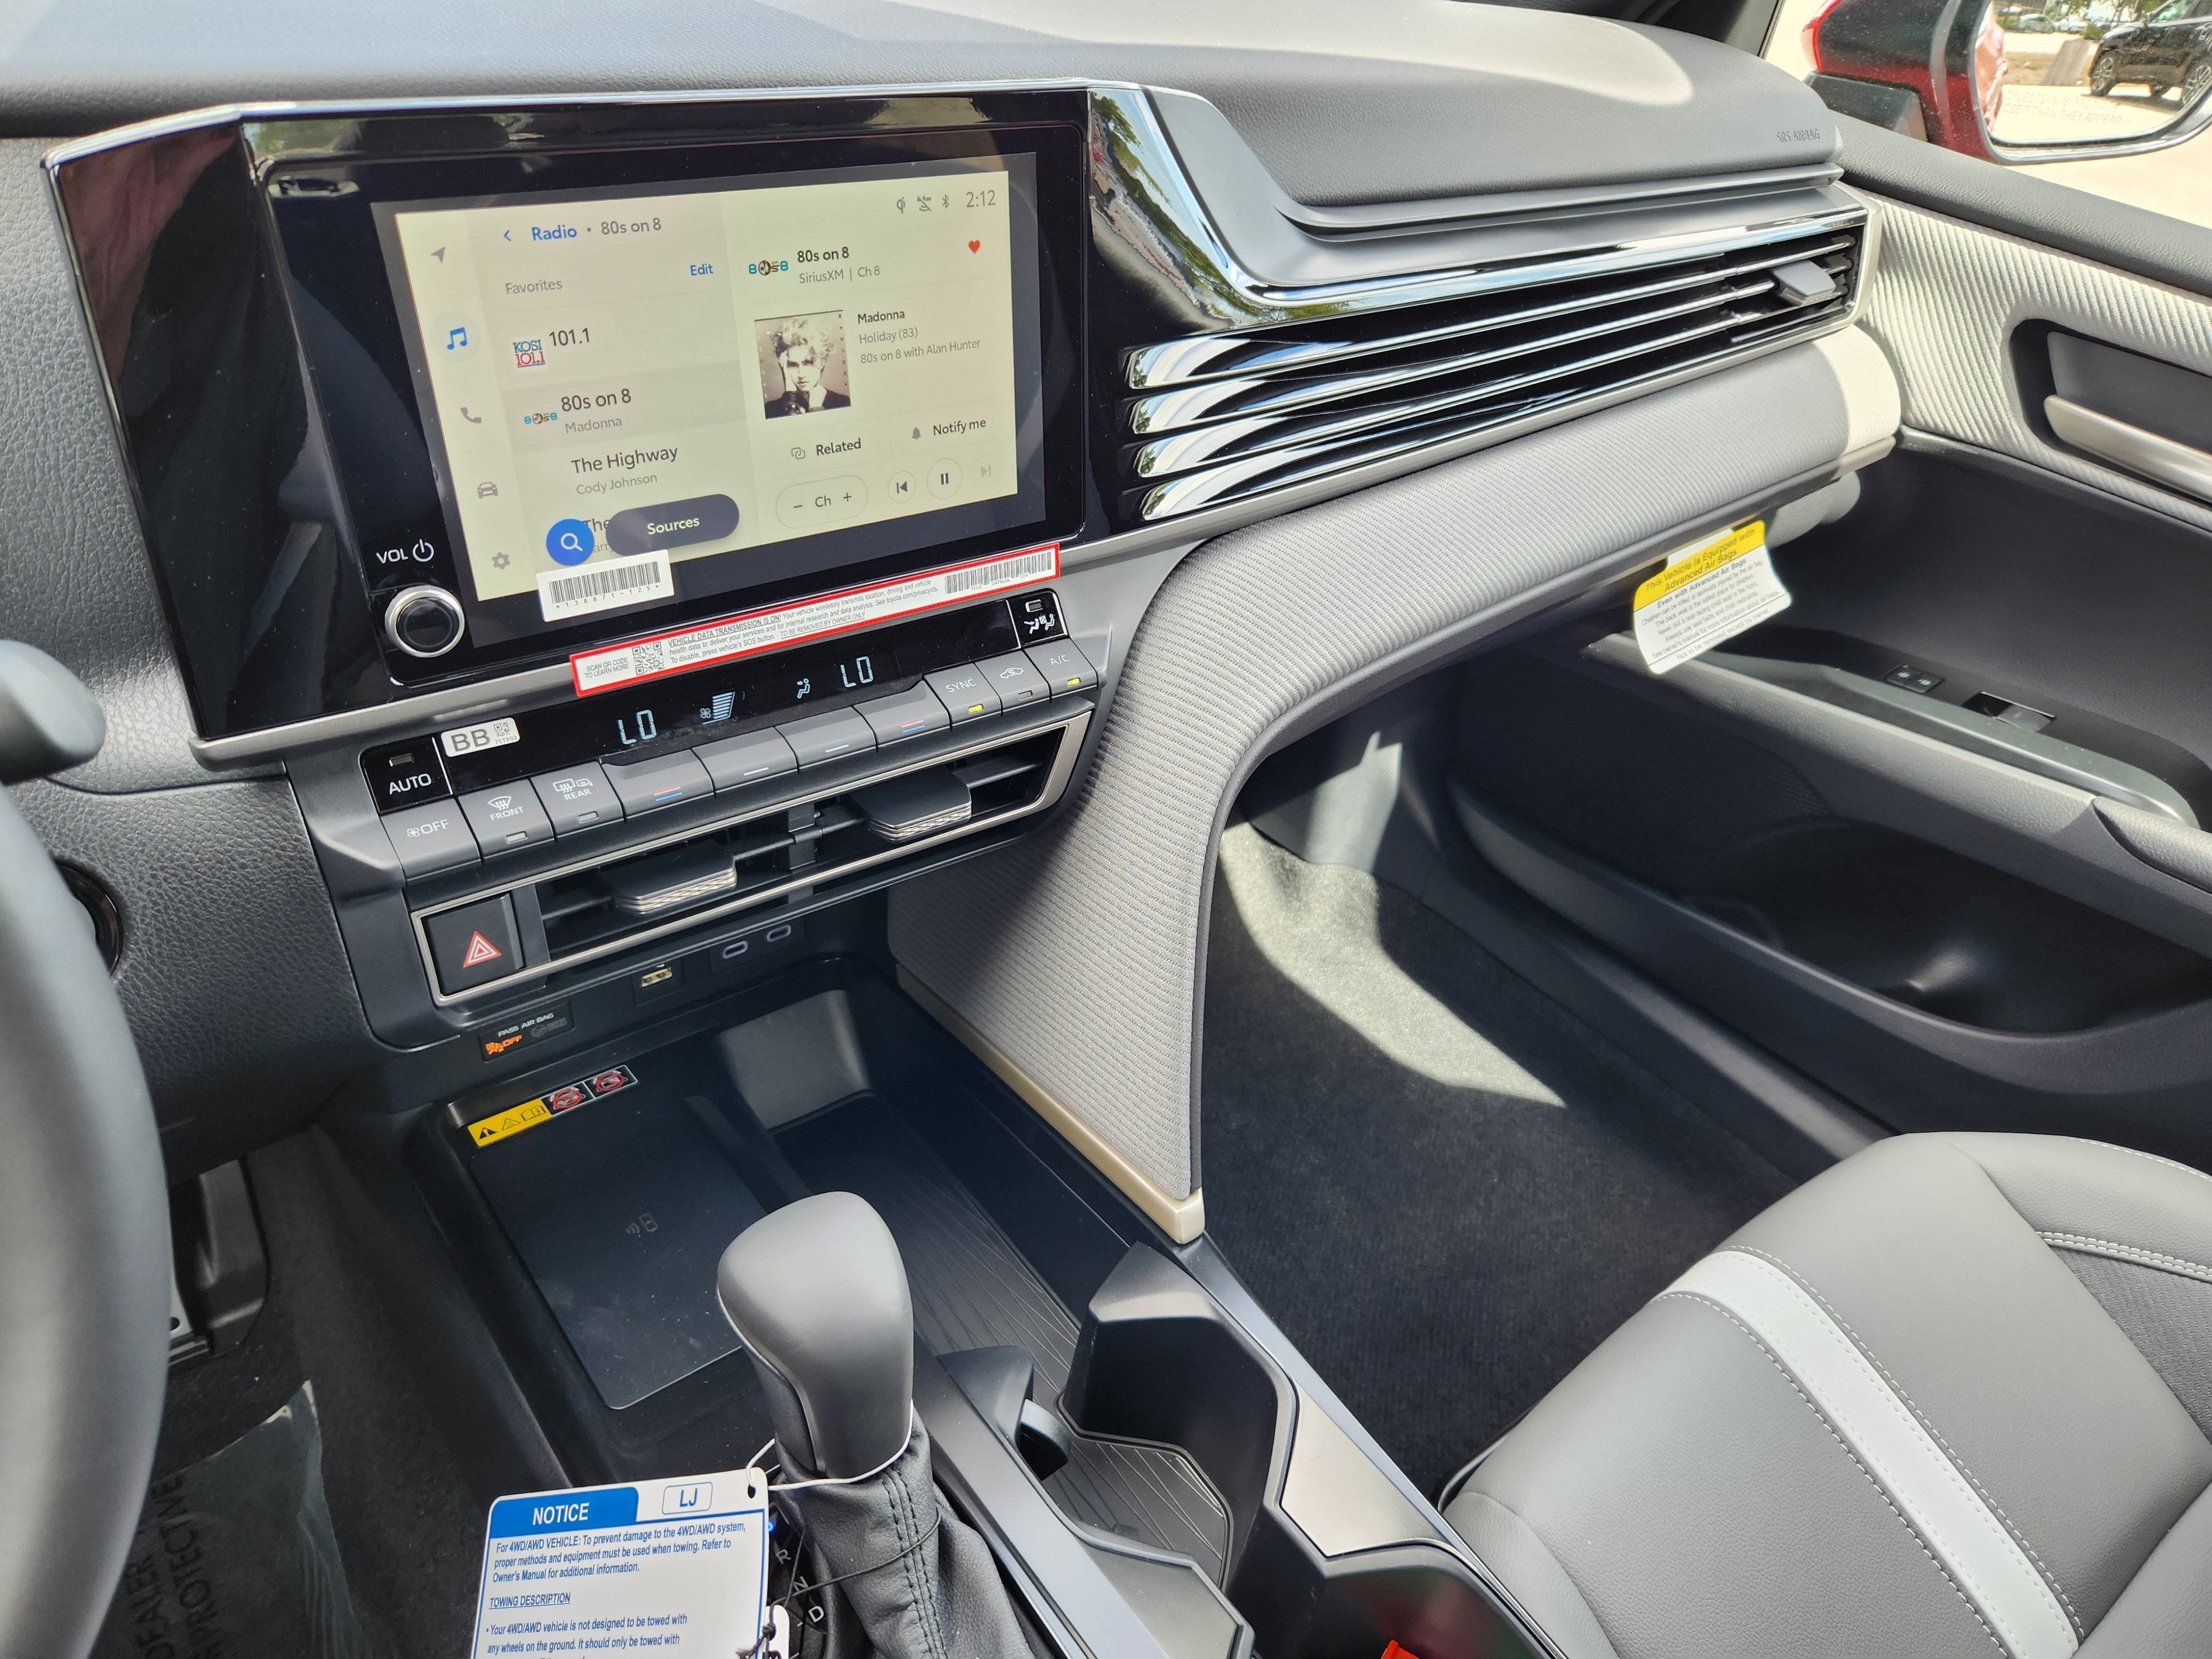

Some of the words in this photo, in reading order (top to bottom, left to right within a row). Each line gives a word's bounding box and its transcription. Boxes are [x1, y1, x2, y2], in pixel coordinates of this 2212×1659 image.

[966, 190, 996, 207] 2:12
[531, 224, 577, 241] Radio
[601, 221, 627, 234] 80s
[630, 222, 649, 232] on
[653, 217, 661, 231] 8
[797, 249, 819, 263] 80s
[822, 251, 839, 260] on
[841, 246, 849, 258] 8
[690, 263, 713, 275] Edit
[799, 269, 843, 283] SiriusXM
[857, 266, 872, 277] Ch
[874, 265, 880, 275] 8
[505, 279, 562, 294] Favorites
[857, 311, 905, 324] Madonna
[549, 327, 589, 346] 101.1
[859, 331, 896, 344] Holiday
[898, 326, 917, 340] (83)
[512, 339, 542, 353] KOSI
[860, 353, 878, 363] 80s
[880, 352, 893, 361] on
[895, 349, 901, 359] 8
[903, 346, 924, 358] with
[926, 343, 947, 354] Alan
[949, 340, 980, 351] Hunter
[515, 351, 546, 367] 101.1
[561, 395, 591, 411] 80s
[595, 393, 617, 406] on
[621, 388, 631, 403] 8
[565, 418, 622, 433] Madonna
[933, 420, 967, 436] Notify
[969, 420, 986, 429] me
[816, 437, 861, 456] Related
[571, 457, 602, 473] The
[606, 447, 677, 469] Highway
[576, 481, 607, 494] Cody
[609, 474, 657, 489] Johnson
[815, 495, 831, 507] Ch
[647, 518, 700, 534] Sources
[375, 548, 408, 564] VOL
[1665, 566, 1703, 592] Advanced
[1704, 560, 1715, 571] Air
[1718, 550, 1738, 564] Bags
[667, 634, 696, 646] VEHICLE
[697, 630, 714, 639] DATA
[714, 618, 762, 637] TRANSMISSION
[770, 614, 781, 623] ON!
[795, 607, 814, 616] vehicle
[815, 601, 840, 611] wirelessly
[841, 596, 864, 606] transmits
[864, 591, 885, 600] location,
[886, 586, 903, 594] driving
[914, 580, 931, 588] vehicle
[669, 646, 687, 655] health
[709, 637, 728, 646] deliver
[742, 628, 765, 638] services
[679, 652, 701, 661] disable,
[702, 648, 717, 657] press
[718, 641, 742, 652] vehicle's
[743, 638, 756, 646] SOS
[757, 634, 776, 643] button.
[586, 663, 602, 672] SCAN
[612, 657, 628, 665] CODE
[1050, 654, 1070, 666] A/C
[593, 667, 612, 676] LEARN
[946, 677, 976, 692] SYNC
[450, 729, 491, 753] BB
[388, 773, 432, 795] AUTO
[563, 787, 592, 801] REAR
[489, 805, 524, 821] FRONT
[420, 819, 449, 834] OFF
[498, 1025, 519, 1037] PASS
[521, 1019, 535, 1029] AIR
[536, 1012, 554, 1023] BAG
[503, 1034, 523, 1047] OFF
[533, 1502, 589, 1526] NOTICE
[679, 1488, 698, 1508] LJ
[496, 1542, 508, 1553] For
[509, 1538, 544, 1552] 4WD/AWD
[546, 1535, 581, 1548] VEHICLE:
[582, 1535, 591, 1545] To
[593, 1532, 621, 1547] prevent
[623, 1531, 652, 1542] damage
[654, 1529, 661, 1538] to
[663, 1527, 675, 1538] the
[677, 1524, 715, 1536] 4WD/AWD
[717, 1522, 745, 1535] system,
[494, 1558, 517, 1570] proper
[517, 1554, 547, 1566] methods
[548, 1552, 562, 1563] and
[563, 1549, 601, 1564] equipment
[601, 1547, 620, 1558] must
[622, 1547, 630, 1557] be
[632, 1545, 650, 1556] used
[652, 1543, 671, 1554] when
[673, 1541, 699, 1553] towing.
[701, 1538, 722, 1550] Refer
[723, 1538, 731, 1548] to
[775, 1548, 791, 1565] R
[493, 1571, 520, 1583] Owner's
[521, 1569, 546, 1580] Manual
[547, 1568, 559, 1578] for
[559, 1564, 594, 1577] additional
[596, 1562, 639, 1574] information.
[490, 1595, 518, 1608] TOWING
[520, 1592, 570, 1605] DESCRIPTION
[807, 1605, 825, 1624] D
[491, 1624, 506, 1635] Your
[507, 1621, 541, 1634] 4WD/AWD
[543, 1620, 568, 1632] vehicle
[569, 1620, 576, 1630] is
[577, 1619, 590, 1630] not
[591, 1616, 625, 1630] designed
[627, 1617, 634, 1627] to
[636, 1616, 645, 1626] be
[647, 1614, 670, 1626] towed
[671, 1613, 687, 1624] with
[487, 1645, 500, 1655] any
[501, 1642, 524, 1652] wheels
[525, 1643, 535, 1652] on
[536, 1641, 547, 1651] the
[548, 1639, 576, 1653] ground.
[578, 1639, 583, 1649] It
[585, 1637, 610, 1648] should
[611, 1636, 627, 1650] only
[629, 1636, 638, 1646] be
[640, 1634, 662, 1646] towed
[664, 1633, 680, 1645] with
